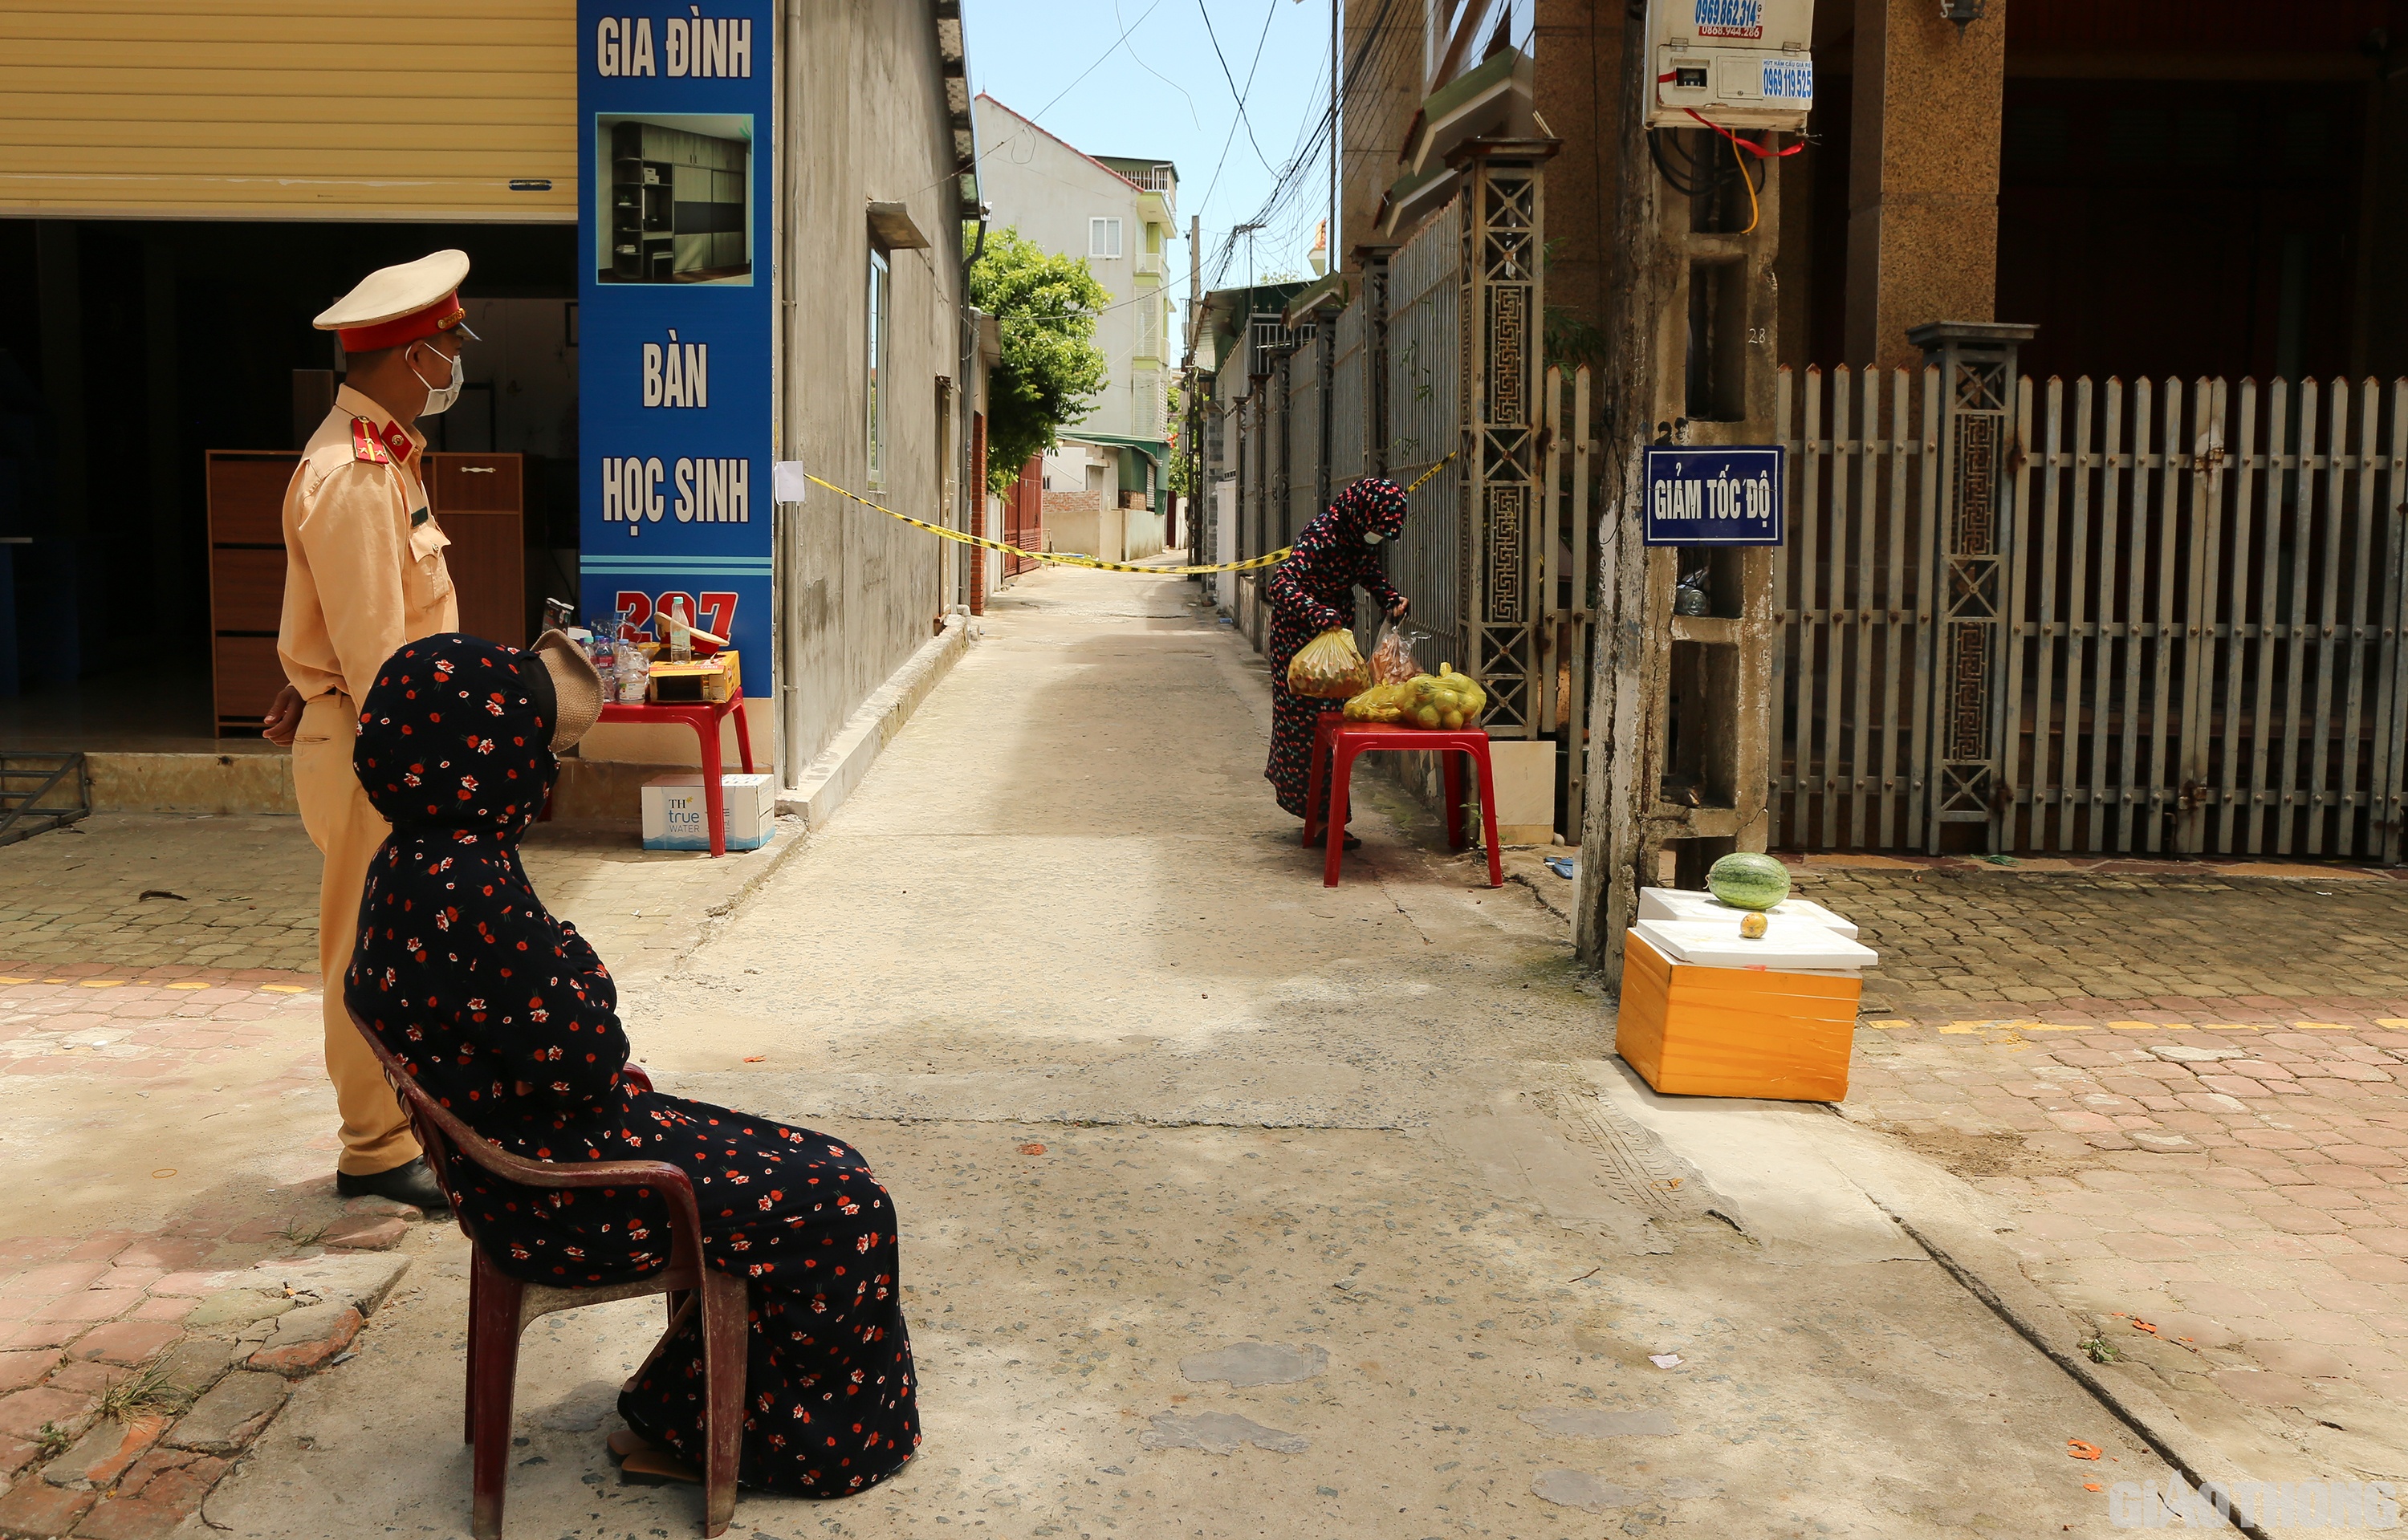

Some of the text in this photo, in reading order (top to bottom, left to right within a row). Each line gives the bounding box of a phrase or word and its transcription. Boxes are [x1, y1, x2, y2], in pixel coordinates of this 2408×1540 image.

[1695, 0, 1757, 26] 0969.862.314
[596, 6, 752, 78] GIA ĐÌNH
[1763, 67, 1812, 98] 0969.119.525
[1748, 327, 1766, 343] 28
[643, 329, 707, 408] BÀN
[603, 457, 749, 536] HỌC SINH
[1654, 462, 1771, 528] GIẢM TỐC ĐỘ
[669, 798, 686, 809] TH
[669, 810, 700, 823] true
[669, 825, 700, 833] WATER
